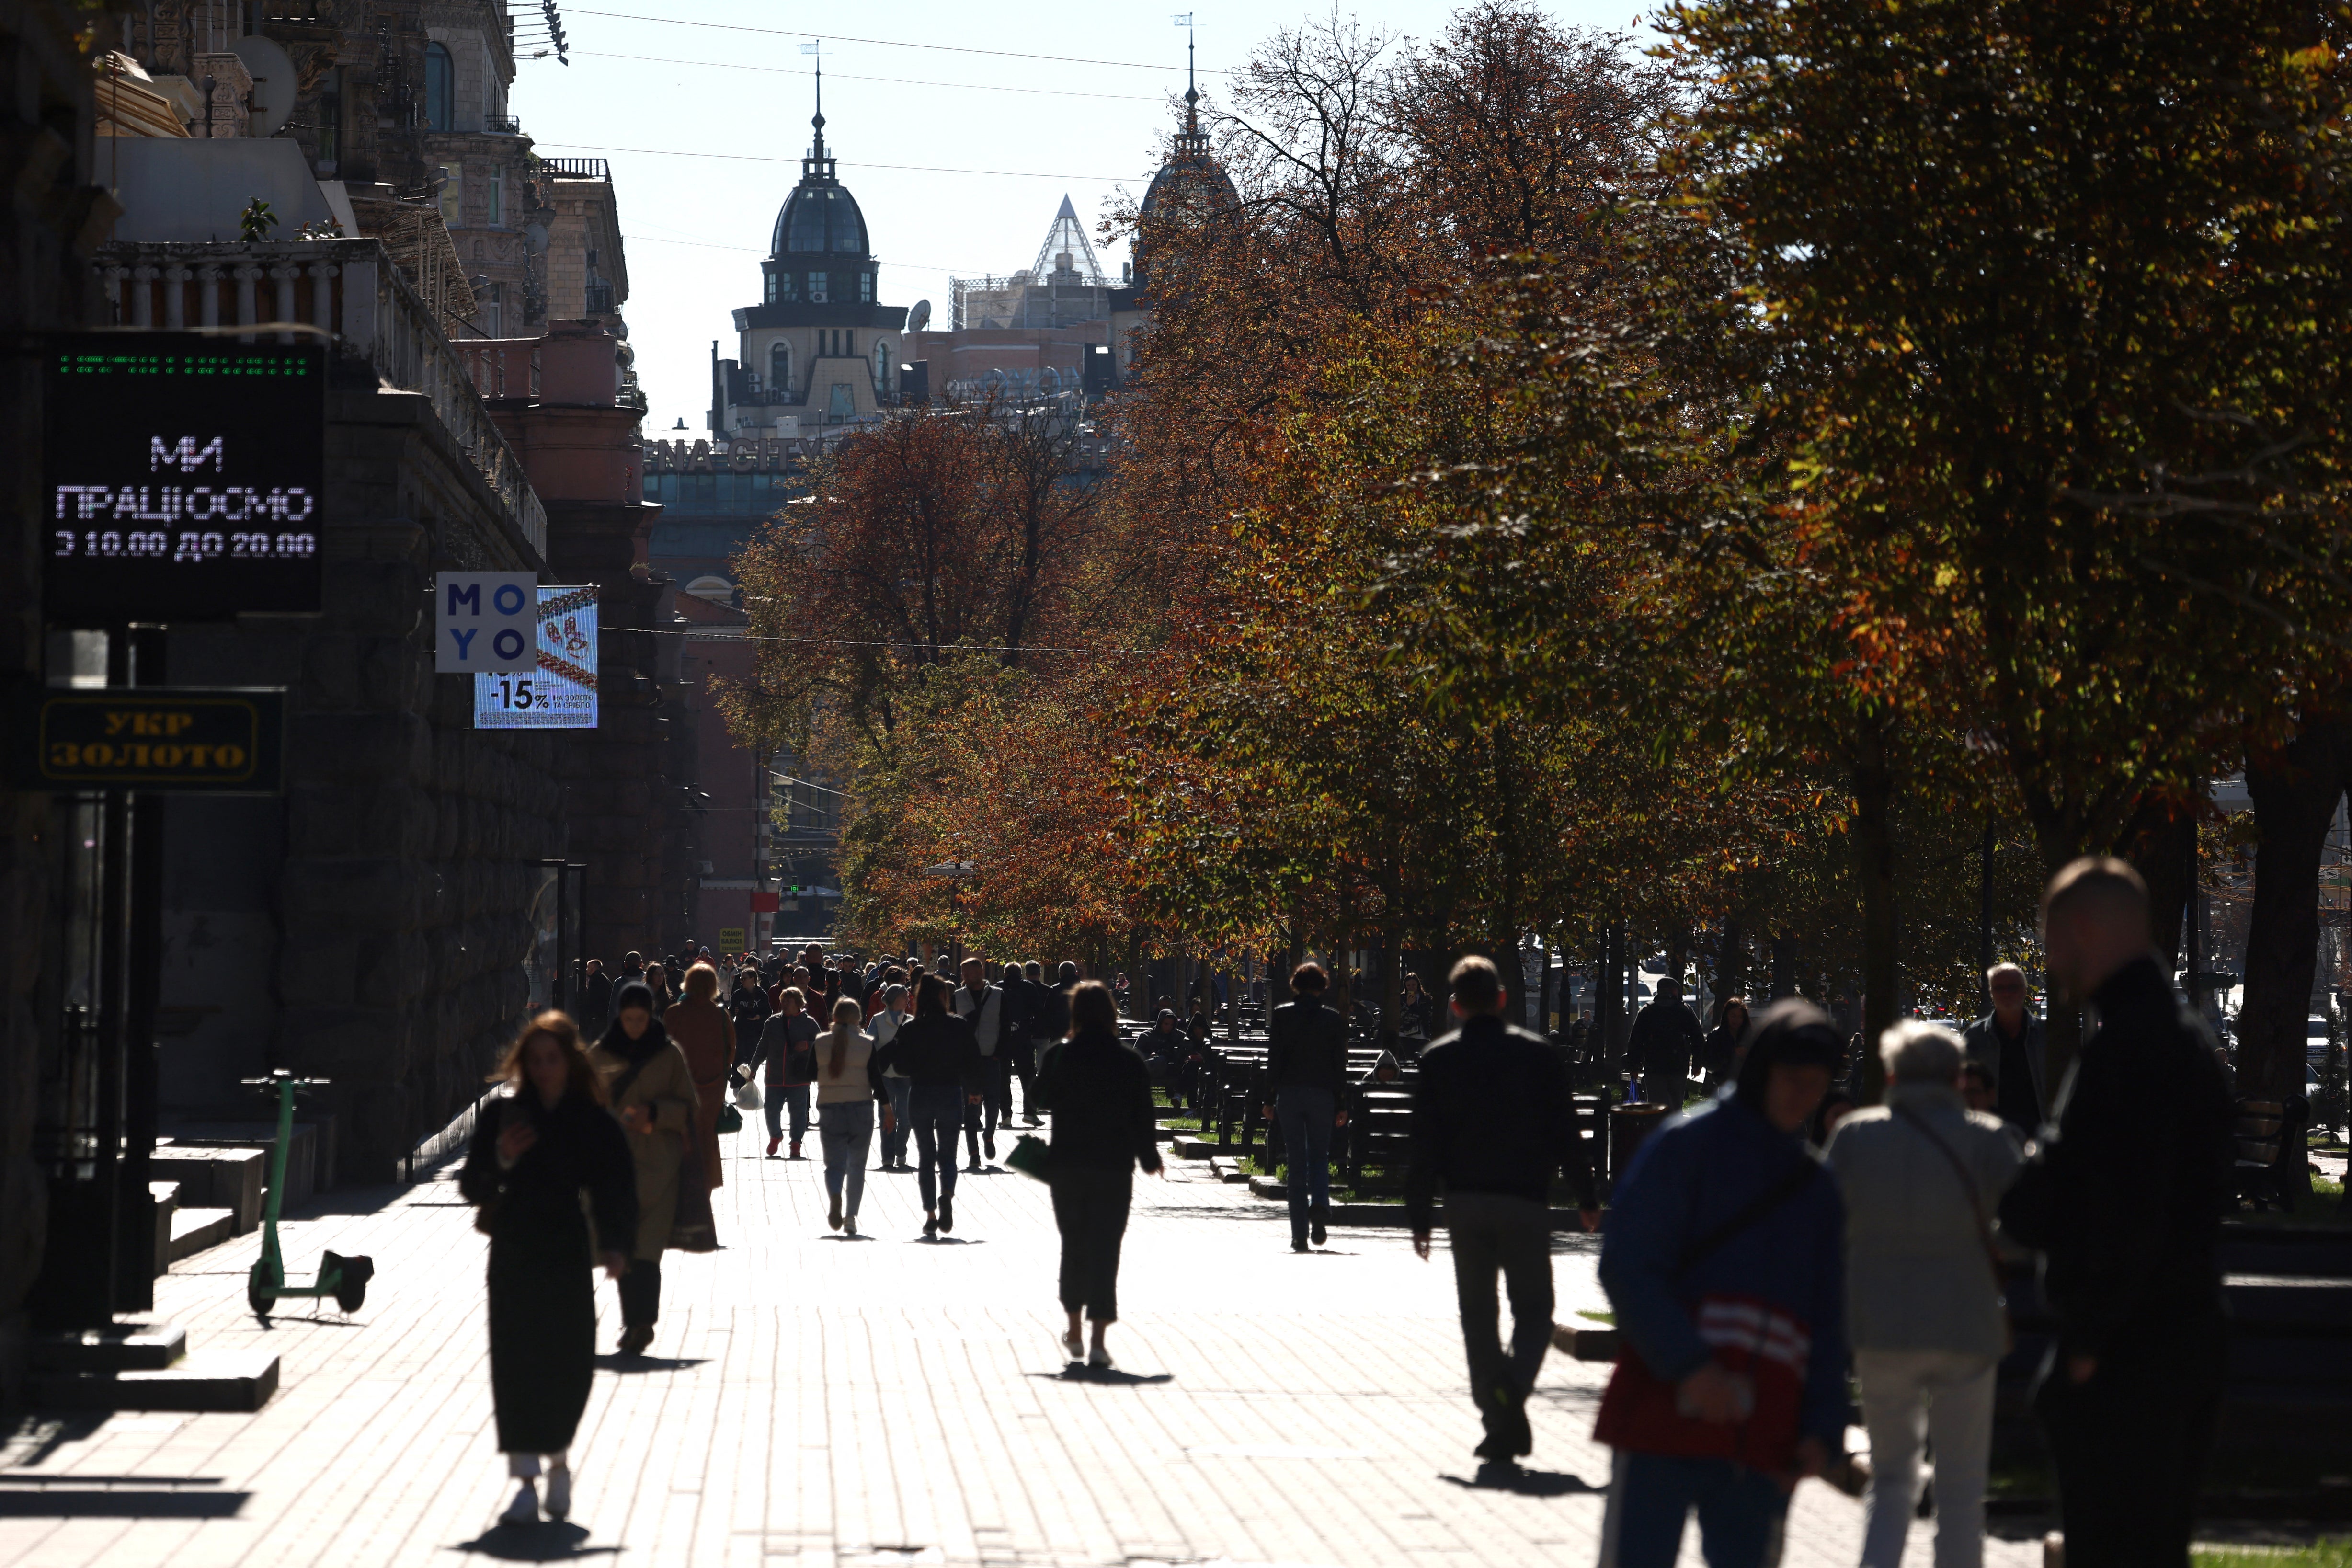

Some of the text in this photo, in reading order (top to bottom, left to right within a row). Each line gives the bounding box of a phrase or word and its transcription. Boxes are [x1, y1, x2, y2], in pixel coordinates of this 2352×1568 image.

[151, 435, 224, 473] МИ
[85, 531, 168, 557] 10.00
[174, 532, 225, 563] ДО
[230, 532, 316, 558] 20.00
[491, 681, 549, 710] -15%
[105, 712, 194, 736] УКР
[50, 743, 246, 768] ЗОЛОТО
